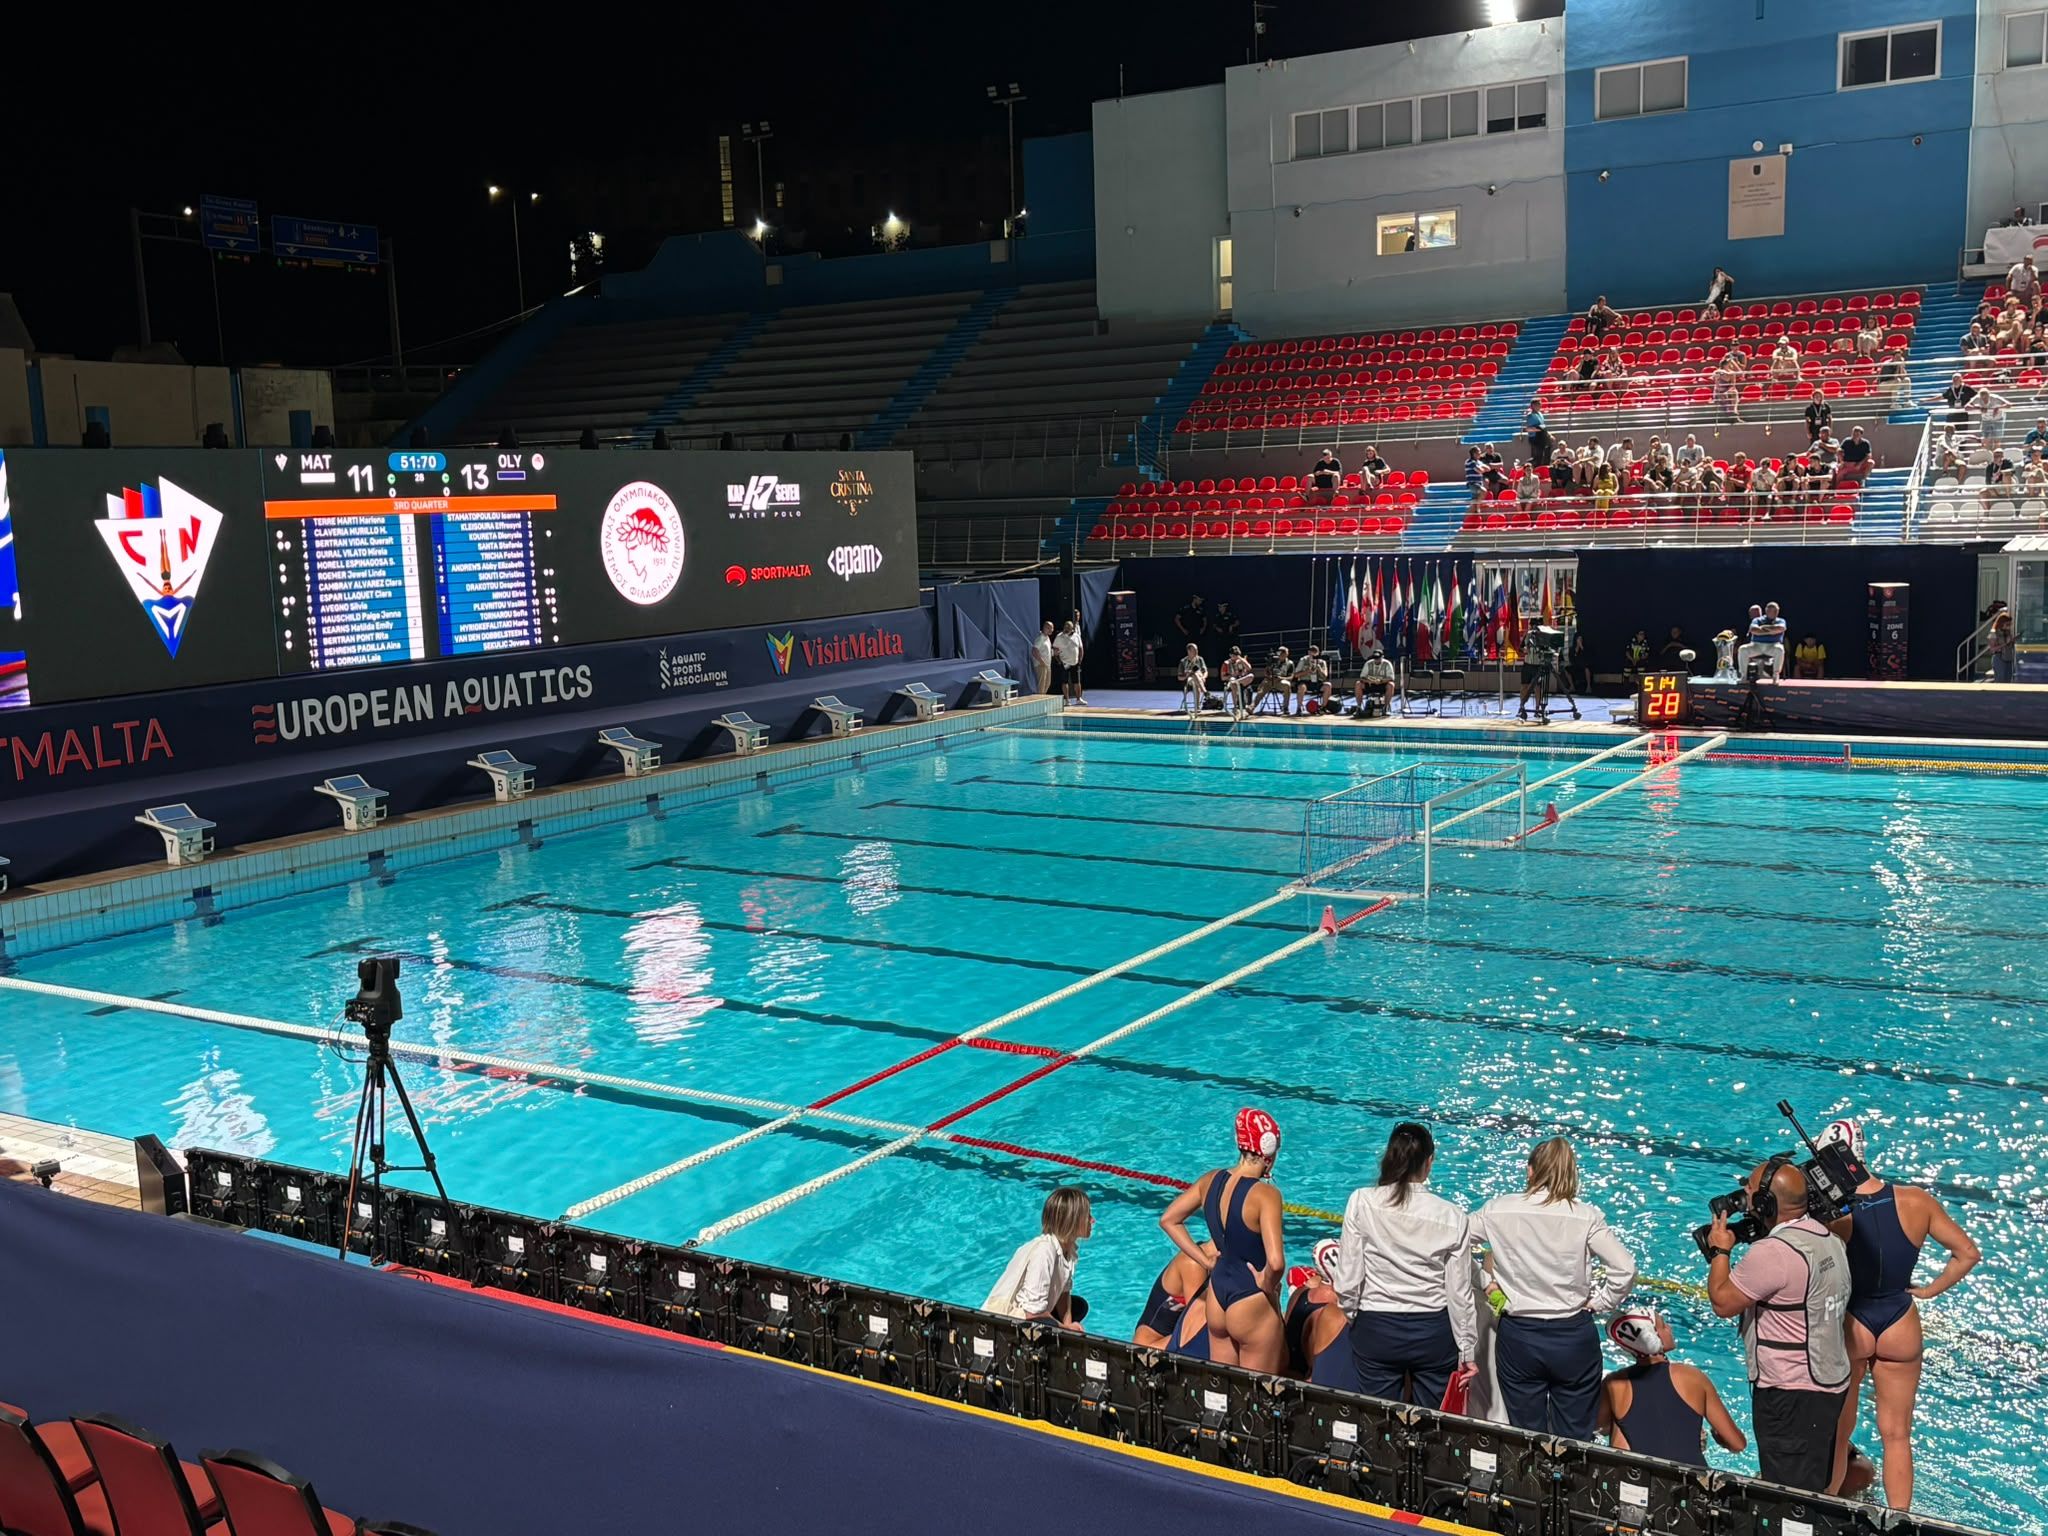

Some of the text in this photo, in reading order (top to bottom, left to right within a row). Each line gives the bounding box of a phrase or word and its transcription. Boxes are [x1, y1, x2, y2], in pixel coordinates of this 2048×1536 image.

[301, 454, 332, 470] MAT
[400, 455, 437, 469] 51:70
[498, 454, 522, 468] OLY
[347, 465, 374, 492] 11
[461, 464, 489, 490] 13
[839, 470, 865, 482] SANTA
[831, 482, 873, 497] CRISTINA
[394, 500, 448, 511] 3RD QUARTER
[751, 565, 811, 580] SPORTMALTA
[1891, 630, 1898, 640] 6
[801, 628, 904, 667] VisitMalta
[672, 652, 706, 665] AQUATIC
[672, 664, 702, 675] SPORTS
[673, 671, 727, 686] ASSOCIATION
[444, 664, 594, 717] AQUATICS
[1648, 693, 1680, 715] 28
[834, 719, 840, 730] 2
[0, 718, 174, 780] MALTA
[738, 736, 744, 748] 3
[627, 756, 633, 768] 4
[497, 779, 504, 792] 5
[346, 807, 352, 820] 6
[168, 839, 174, 853] 7
[186, 836, 193, 852] 7
[1253, 1114, 1272, 1133] 13
[1829, 1124, 1841, 1141] 3
[1617, 1322, 1642, 1342] 12
